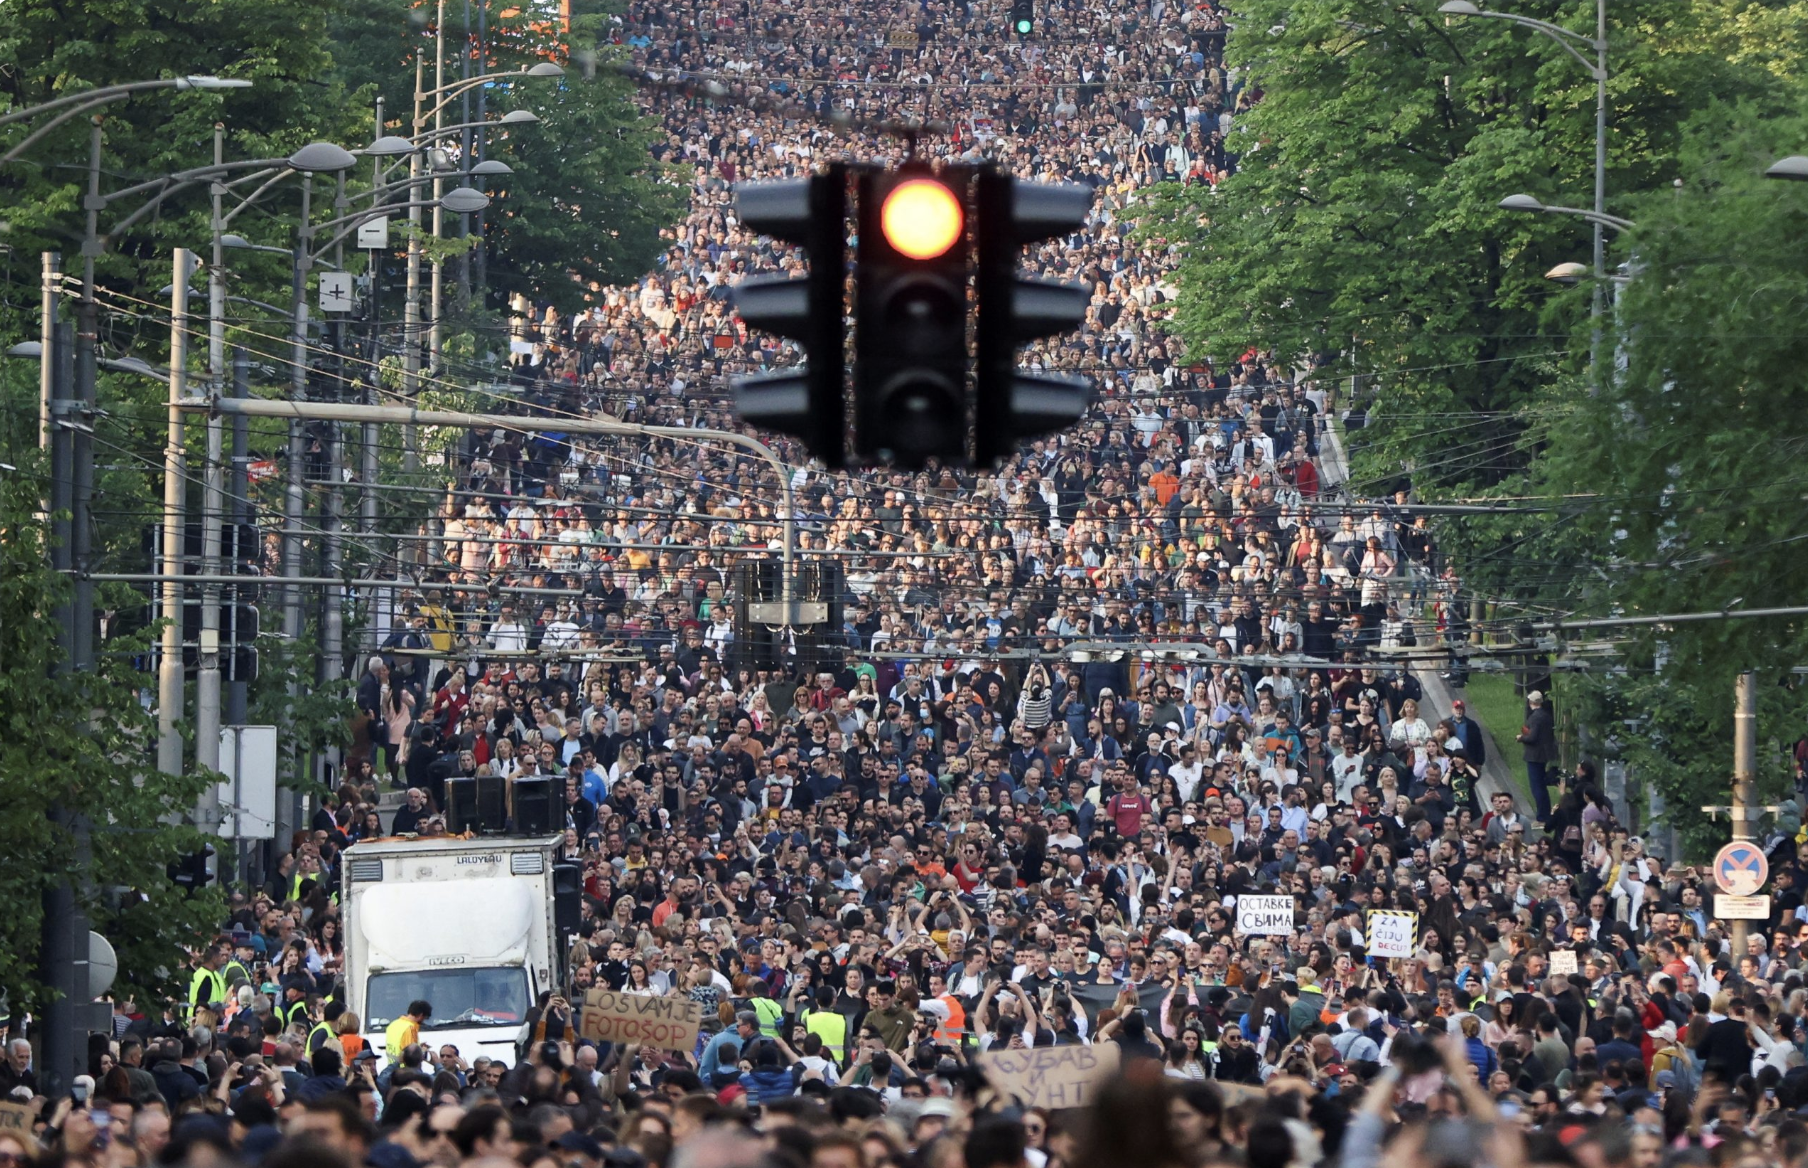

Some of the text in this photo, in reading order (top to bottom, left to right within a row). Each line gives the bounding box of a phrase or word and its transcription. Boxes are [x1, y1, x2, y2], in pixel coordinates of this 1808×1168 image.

[1240, 898, 1293, 911] ОСТАВКЕ
[1242, 912, 1292, 929] СВИМА
[429, 956, 465, 966] IVECO
[584, 990, 698, 1023] LOŠ VAM JE
[584, 1012, 687, 1046] FOTOŠOP
[1021, 1080, 1093, 1106] УНТ
